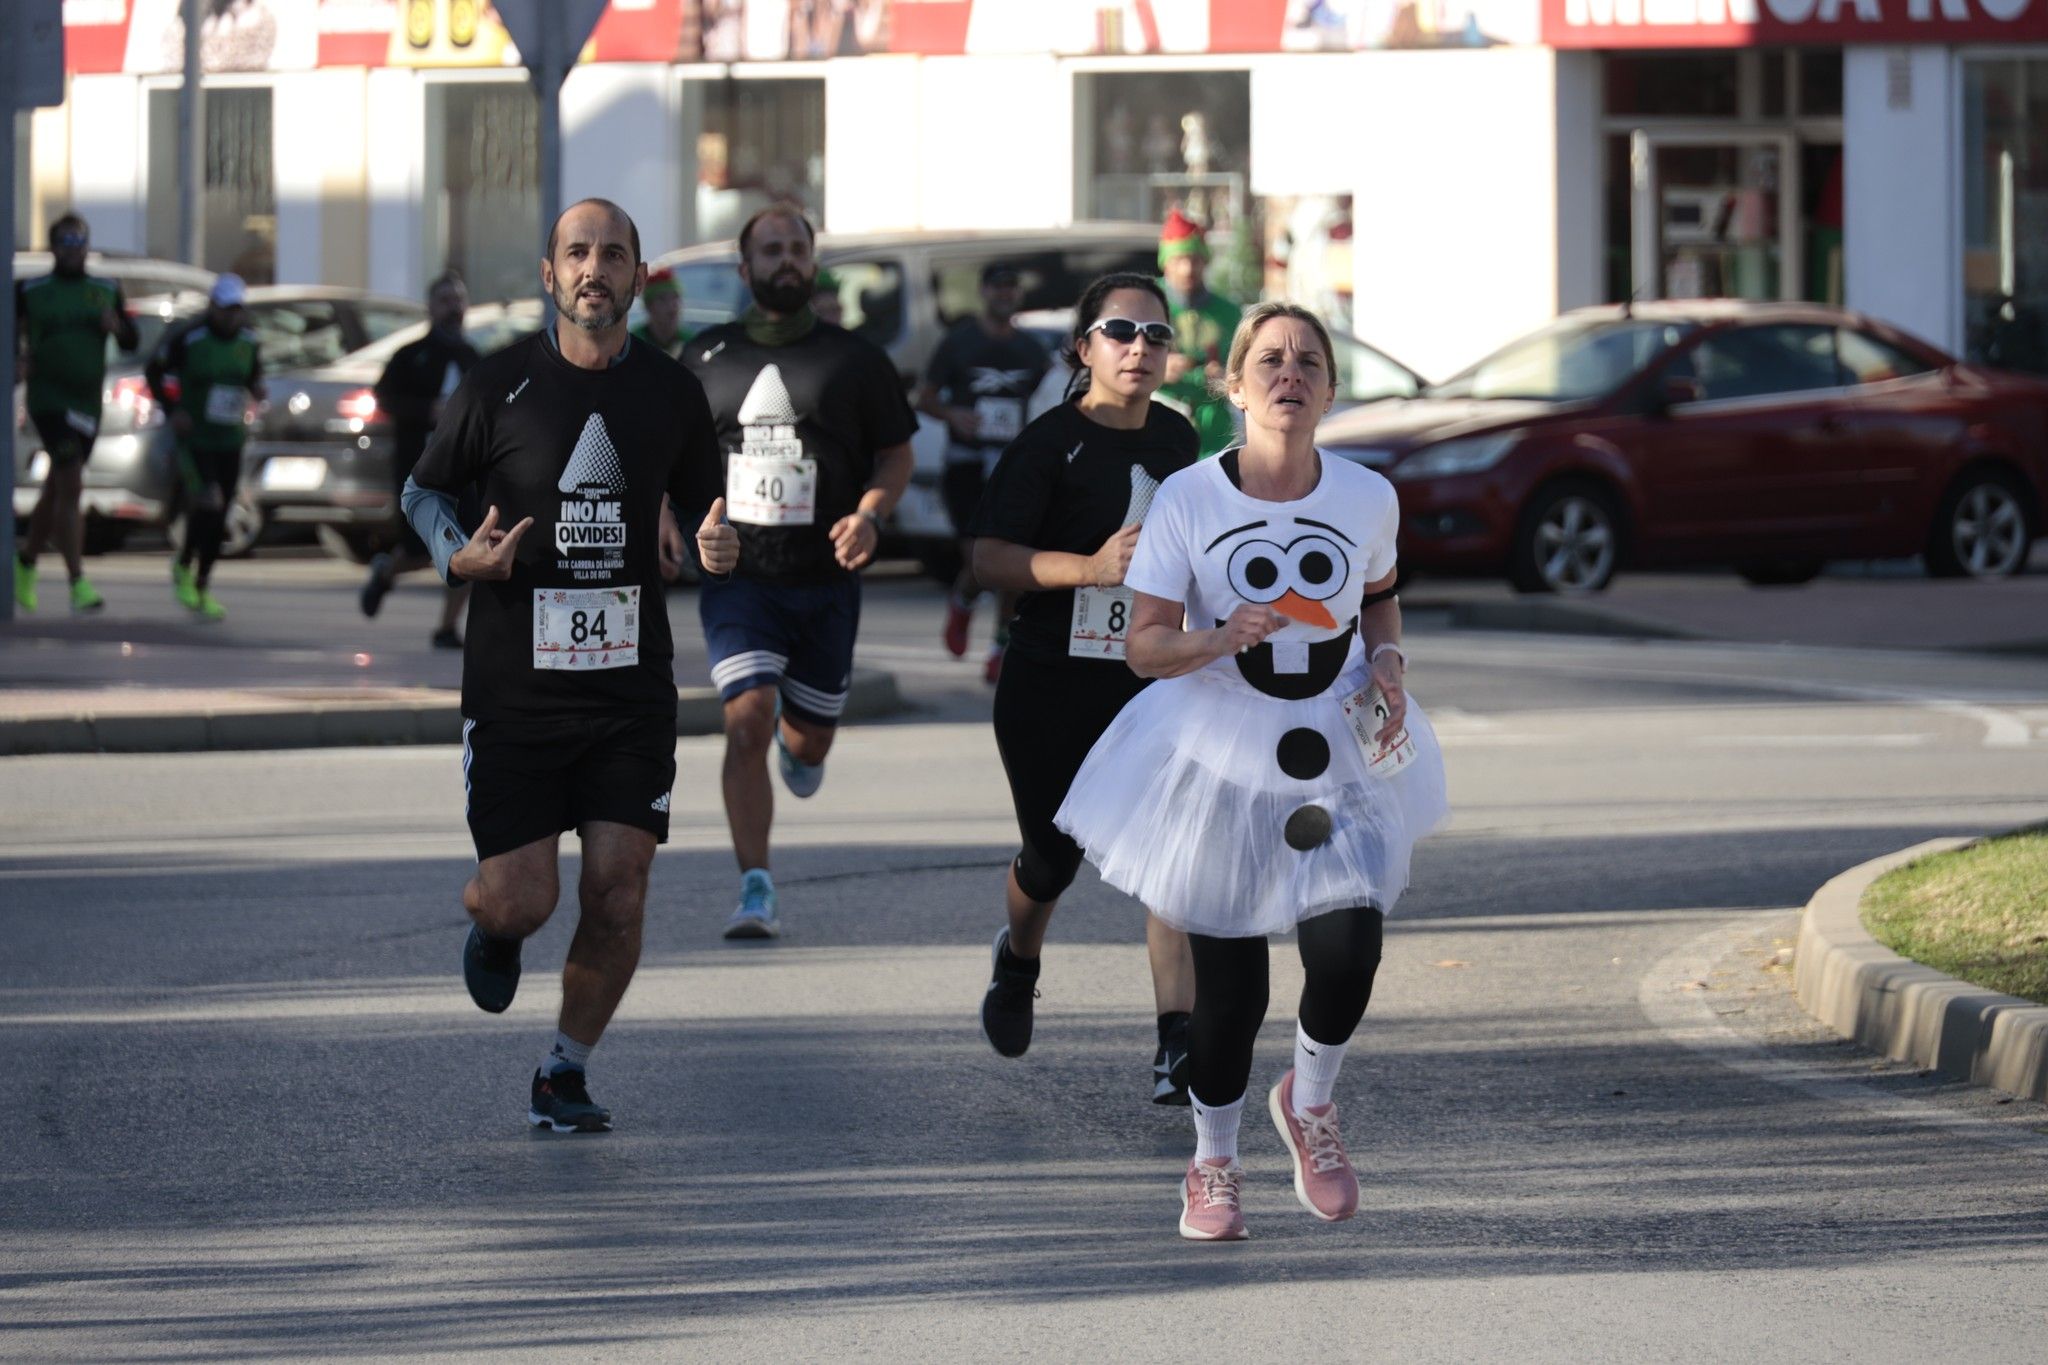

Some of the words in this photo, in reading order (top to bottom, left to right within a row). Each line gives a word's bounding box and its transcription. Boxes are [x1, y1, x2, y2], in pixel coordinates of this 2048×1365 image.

[755, 477, 783, 502] 40
[595, 501, 622, 522] ME
[559, 526, 623, 544] OLVIDES!
[557, 560, 569, 569] XIX
[570, 560, 595, 569] CARRERA
[595, 560, 603, 569] DE
[603, 559, 625, 569] NAVIDAD
[574, 570, 589, 580] VILLA
[590, 570, 597, 579] DE
[598, 570, 612, 579] ROTA
[571, 610, 607, 643] 84
